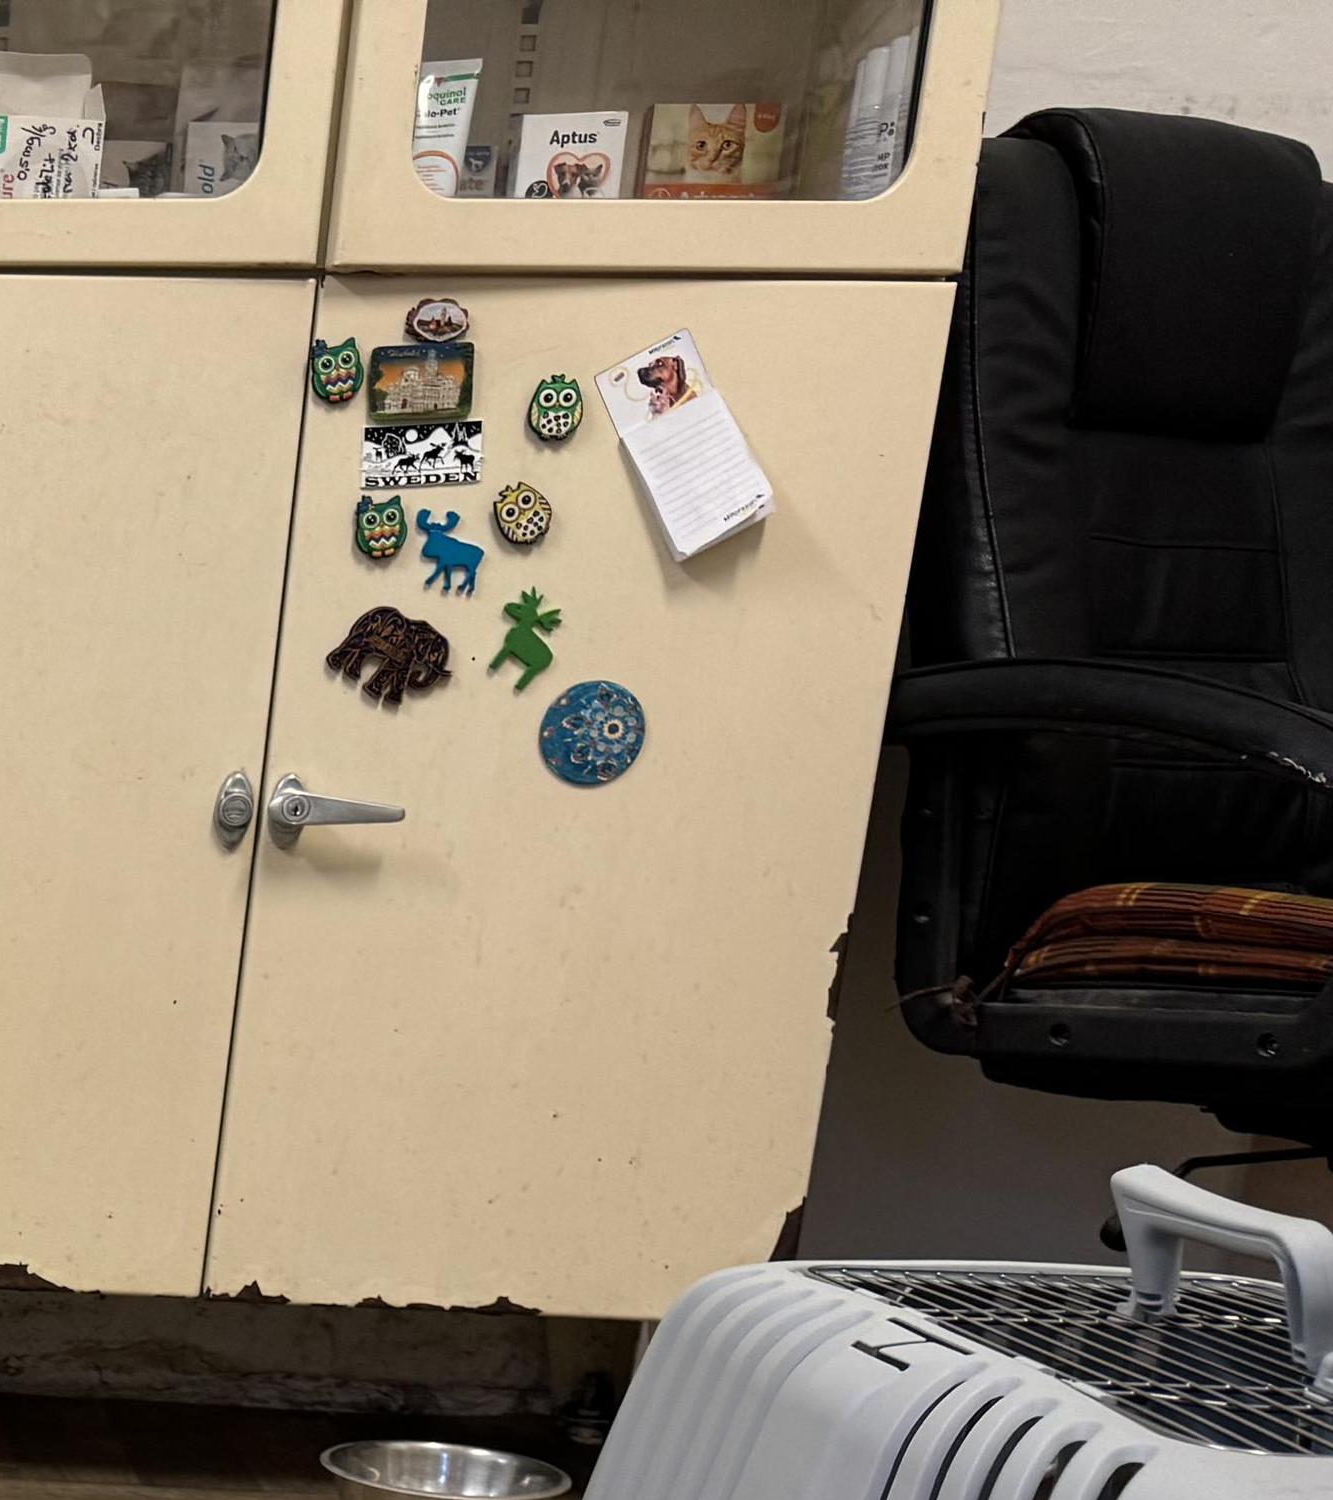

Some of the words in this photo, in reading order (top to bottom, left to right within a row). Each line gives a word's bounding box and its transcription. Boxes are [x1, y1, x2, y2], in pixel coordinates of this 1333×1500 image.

[427, 86, 466, 103] oquinol
[439, 97, 466, 106] CARE
[549, 129, 598, 147] Aptus
[198, 164, 215, 194] old
[364, 471, 479, 488] SWEDEN
